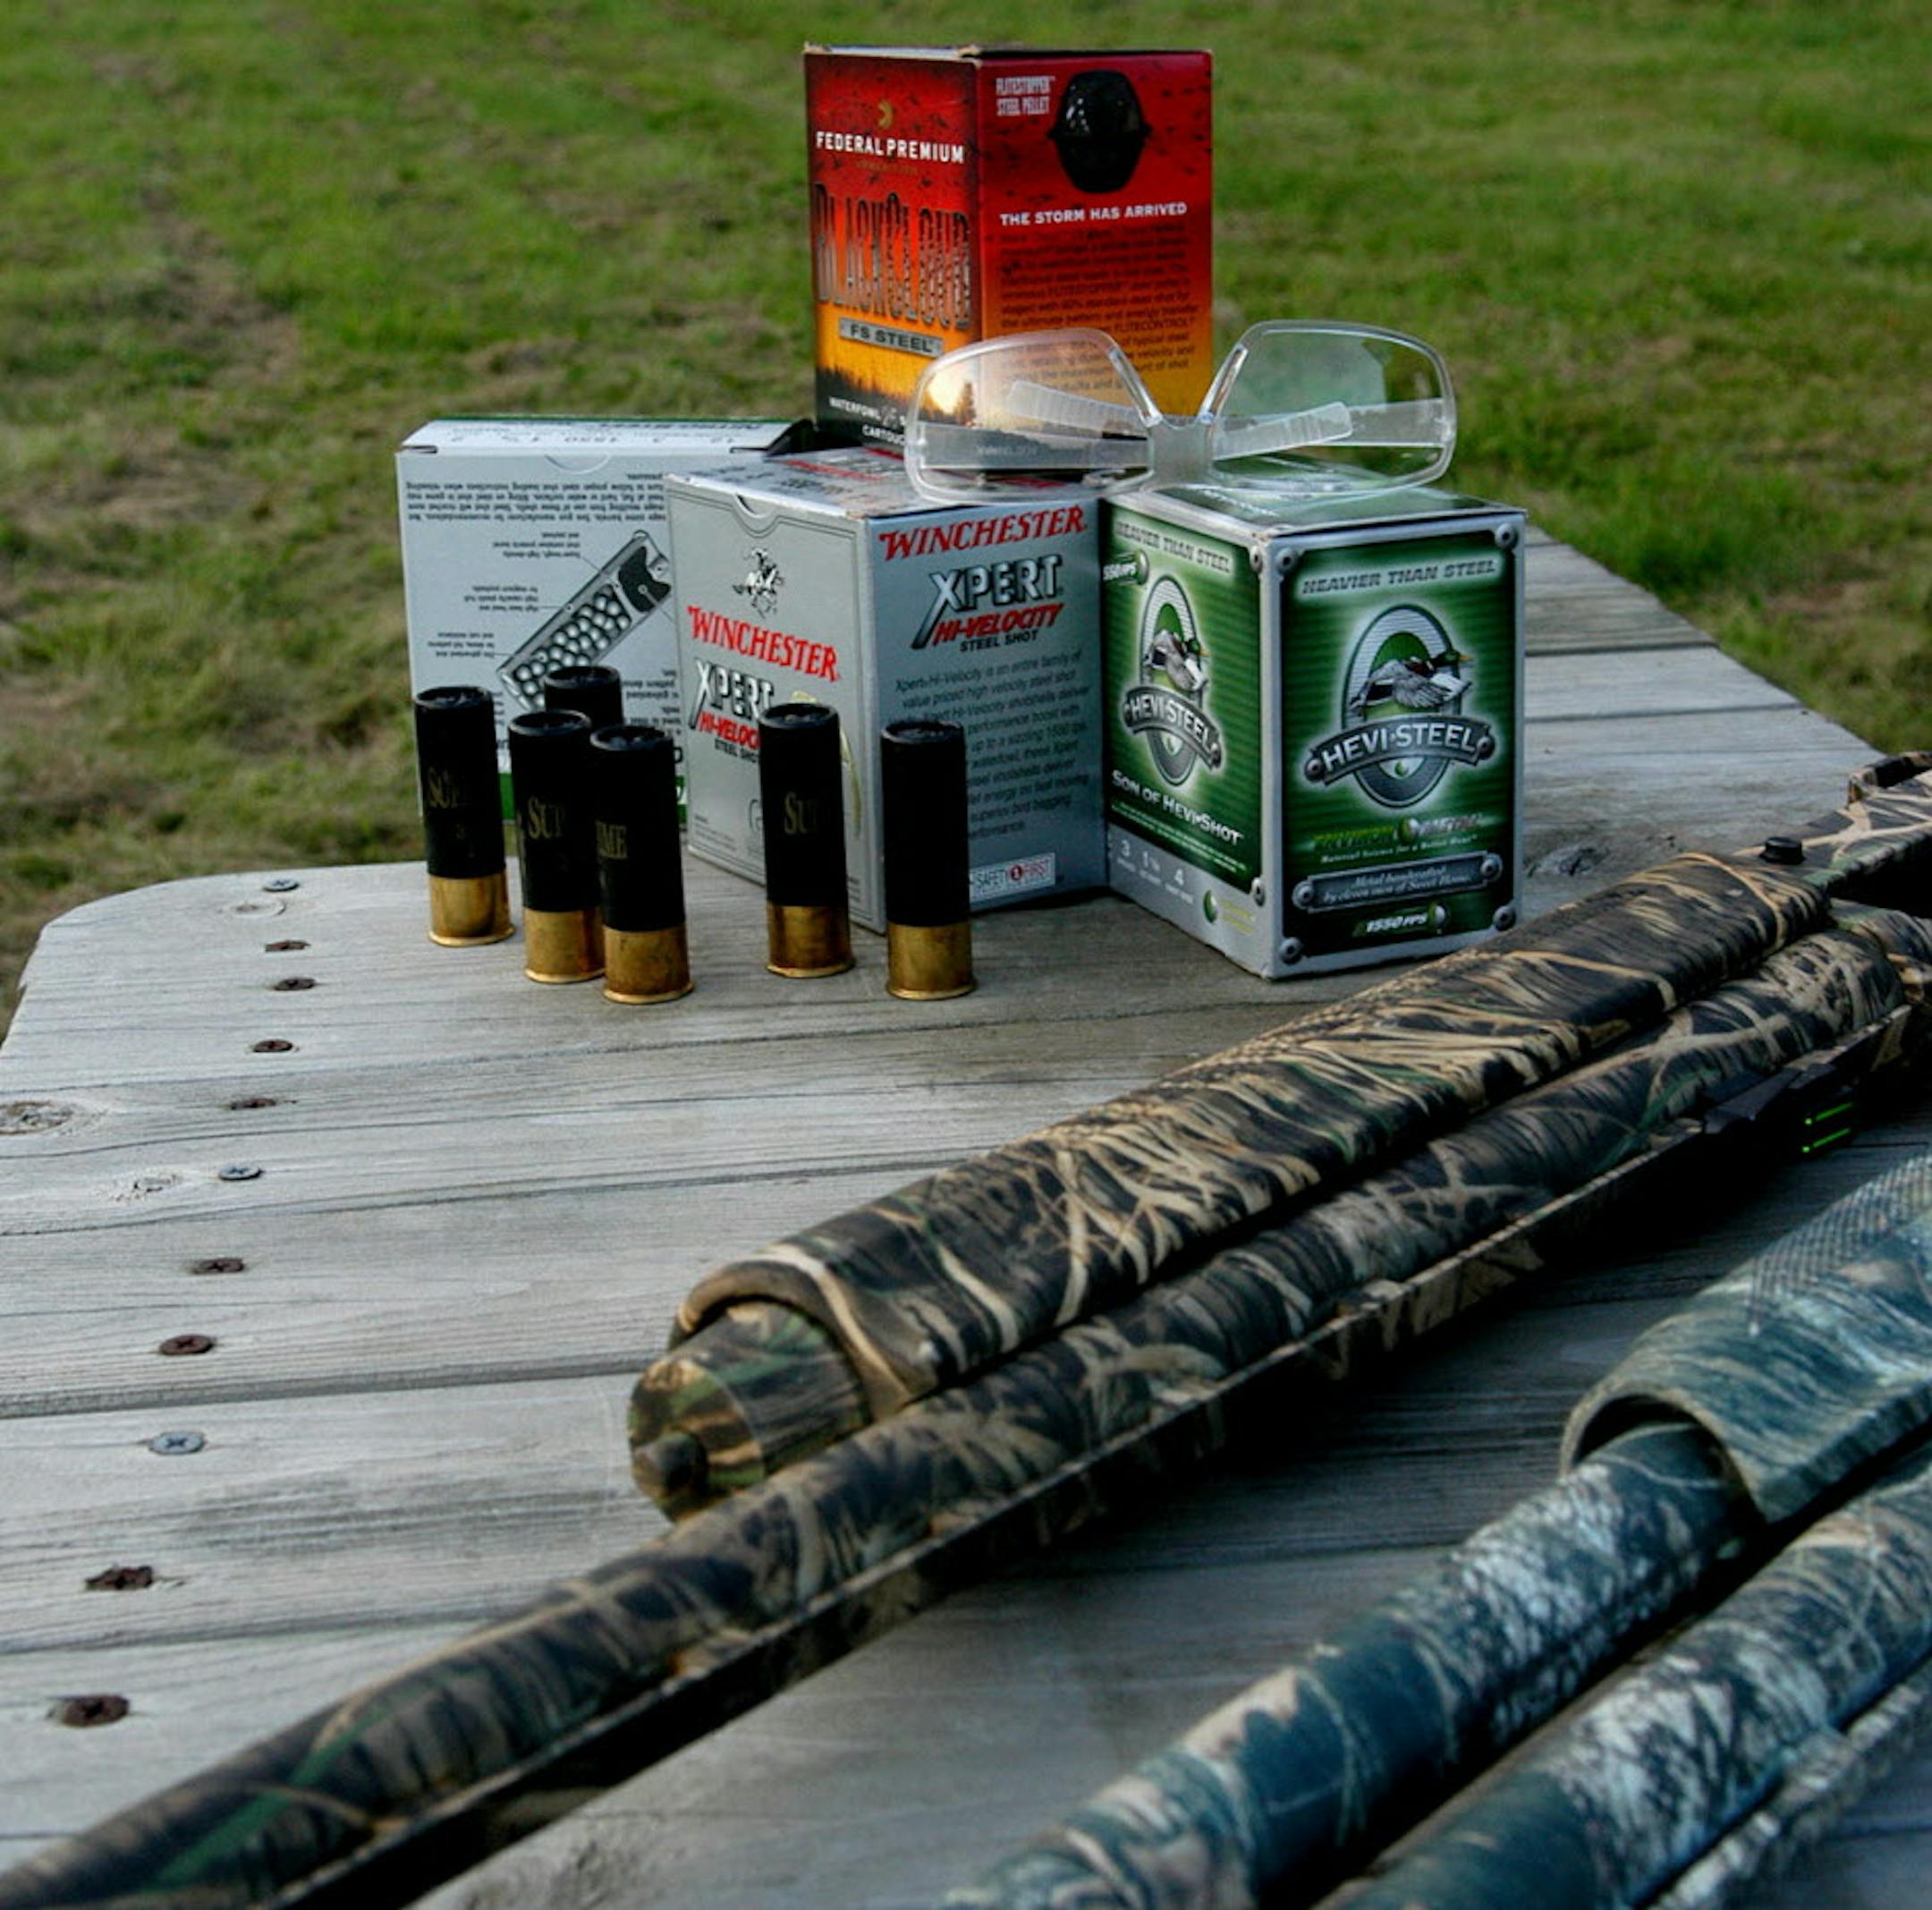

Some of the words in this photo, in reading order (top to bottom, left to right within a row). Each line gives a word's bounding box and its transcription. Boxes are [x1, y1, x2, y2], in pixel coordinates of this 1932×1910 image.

[816, 131, 884, 156] FEDERAL
[886, 138, 964, 163] PREMIUM
[1000, 212, 1030, 226] THE
[1035, 208, 1084, 224] STORM
[1089, 207, 1120, 220] HAS
[1124, 202, 1187, 218] ARRIVED
[851, 324, 869, 338] FS
[876, 330, 932, 352] STEEL
[879, 505, 1087, 561] WINCHESTER
[1164, 537, 1194, 560] THAN
[1197, 548, 1230, 573] STEEL
[1302, 573, 1380, 594] HEAVIER
[1388, 565, 1437, 584] THAN
[1444, 559, 1496, 578] STEEL
[911, 555, 1063, 649] XPERT
[933, 604, 1064, 645] HI-VELOCITY
[960, 636, 1000, 652] STEEL
[1004, 629, 1038, 647] SHOT
[688, 606, 841, 682] WINCHESTER
[689, 658, 775, 729] XPERT
[697, 710, 759, 749] HI-VELOC
[1112, 769, 1140, 797] SON
[1142, 787, 1161, 804] OF
[1122, 839, 1131, 856] 3
[1174, 869, 1184, 886] 4
